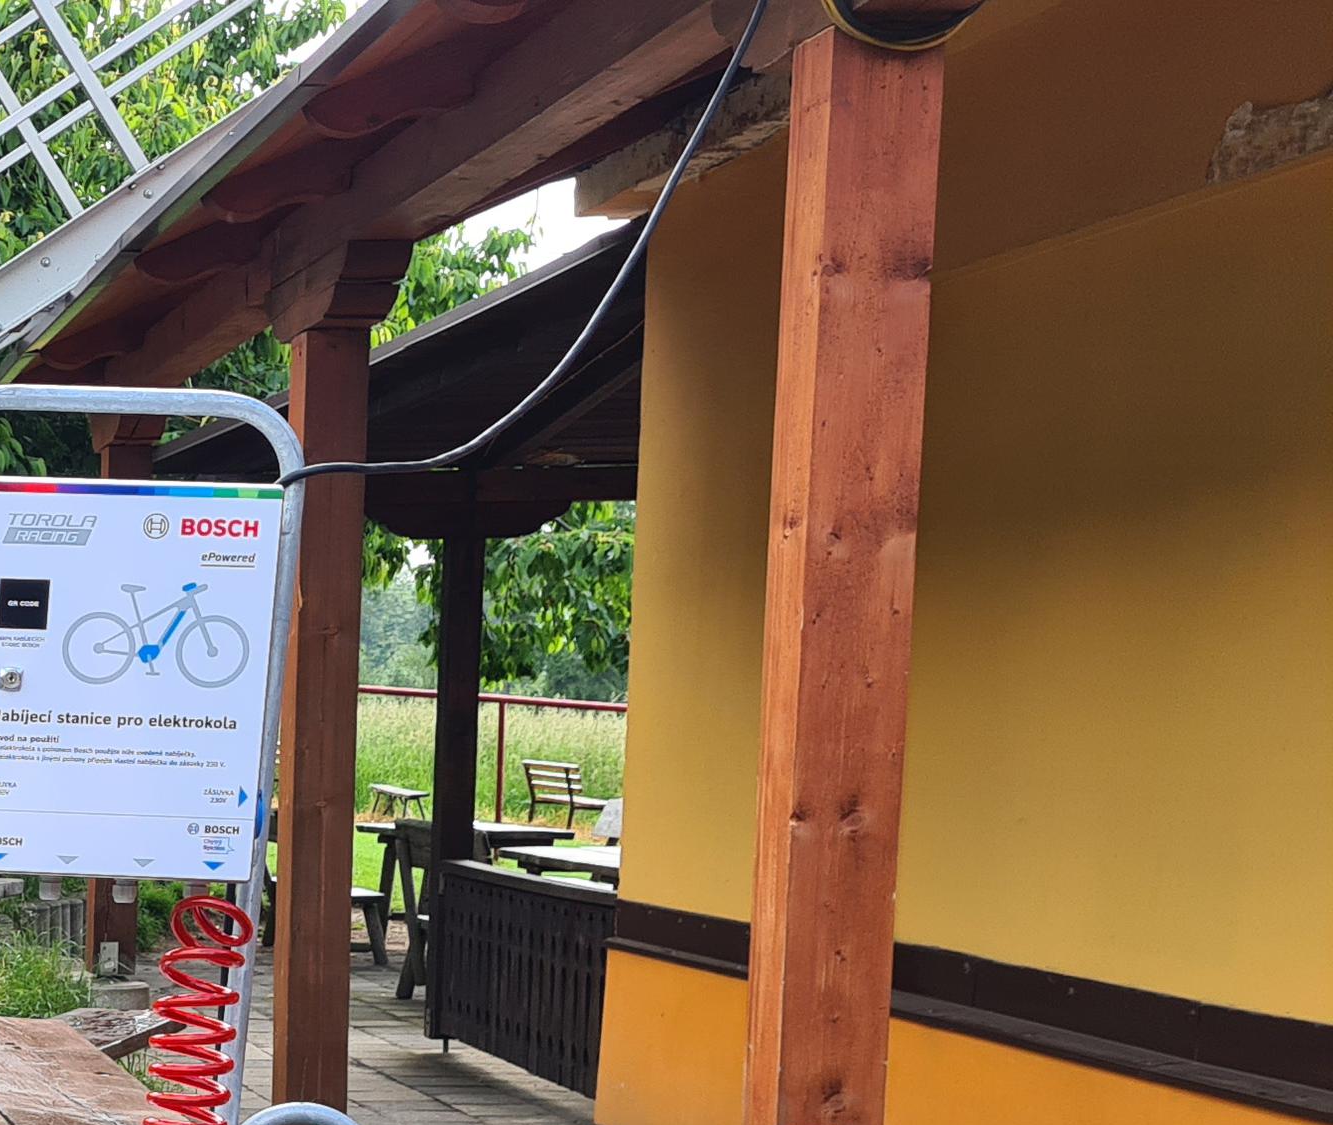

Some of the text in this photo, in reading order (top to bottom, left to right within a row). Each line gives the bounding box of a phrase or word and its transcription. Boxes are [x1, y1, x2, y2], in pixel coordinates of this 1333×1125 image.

[8, 513, 97, 528] TOROLA
[180, 518, 259, 538] BOSCH
[14, 530, 80, 543] RACING
[201, 552, 256, 563] ePowered
[57, 712, 112, 725] stanice
[117, 716, 143, 728] pro
[149, 714, 237, 729] elektrokola
[30, 735, 60, 743] použití
[204, 825, 240, 835] BOSCH
